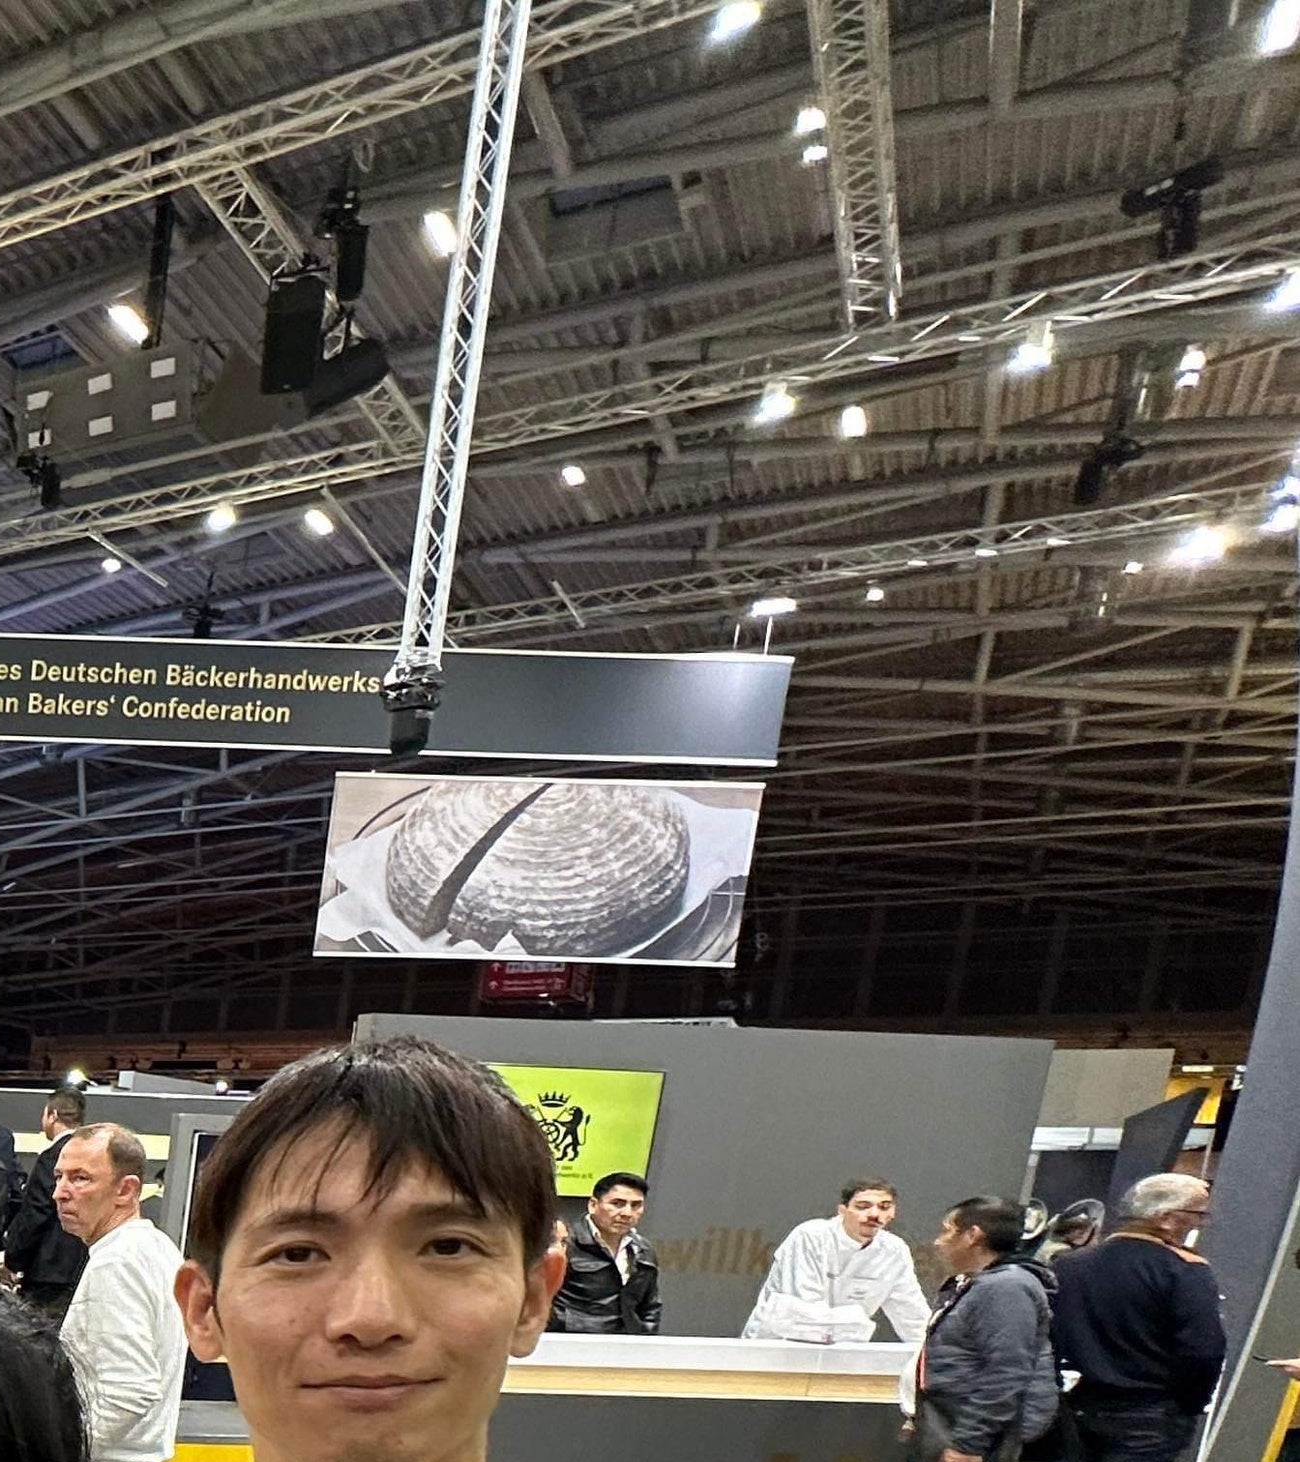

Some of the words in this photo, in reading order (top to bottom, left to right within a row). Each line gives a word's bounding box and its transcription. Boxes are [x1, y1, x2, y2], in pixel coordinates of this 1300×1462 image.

[31, 660, 158, 687] Deutschen
[166, 662, 381, 694] Bäckerhandwerks
[122, 695, 291, 725] Confederation
